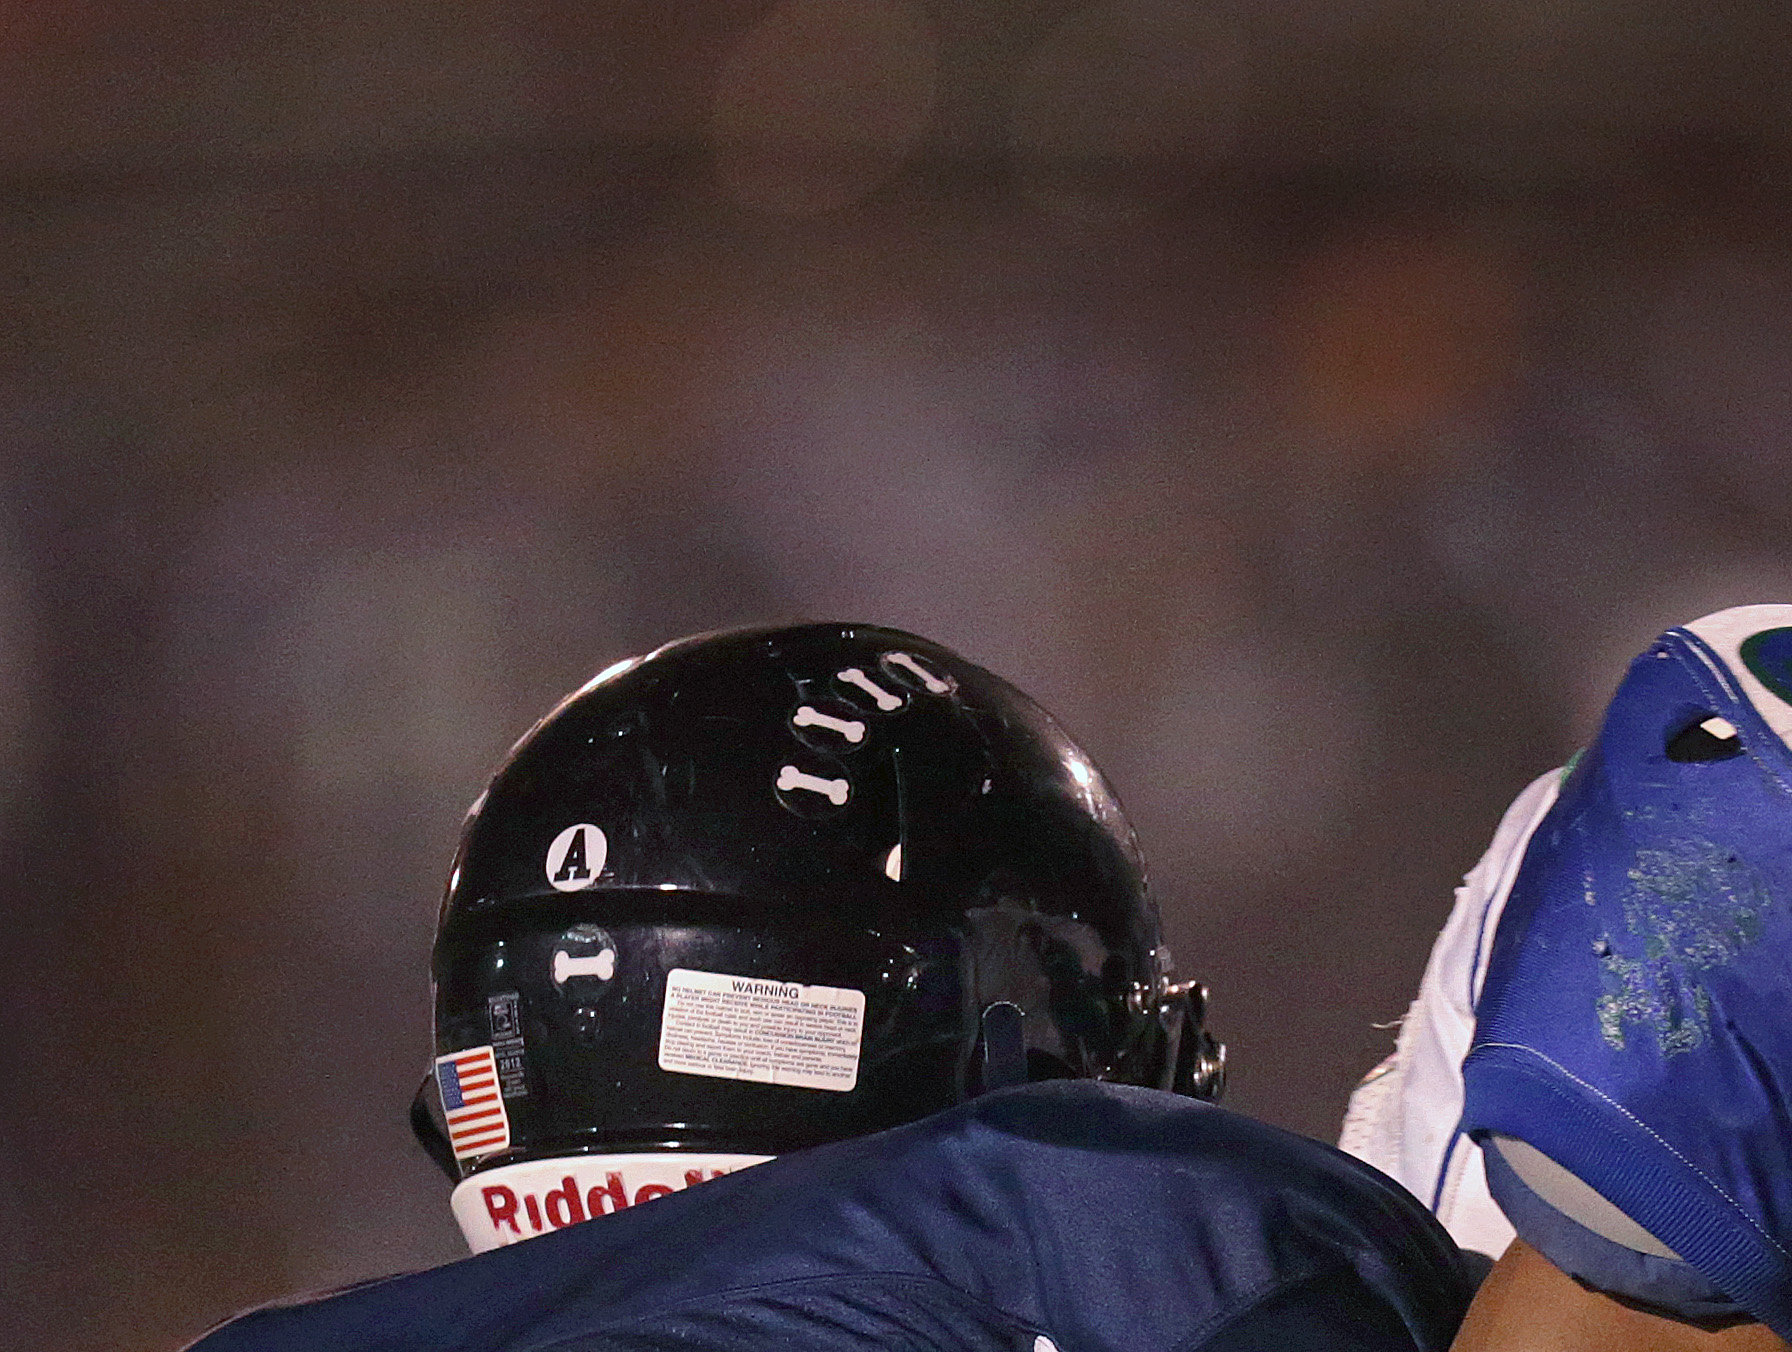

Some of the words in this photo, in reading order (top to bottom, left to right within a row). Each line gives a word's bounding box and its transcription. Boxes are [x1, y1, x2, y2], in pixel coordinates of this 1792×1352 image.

[553, 828, 591, 882] A
[732, 980, 799, 999] WARNING
[481, 1170, 726, 1236] Ridd
